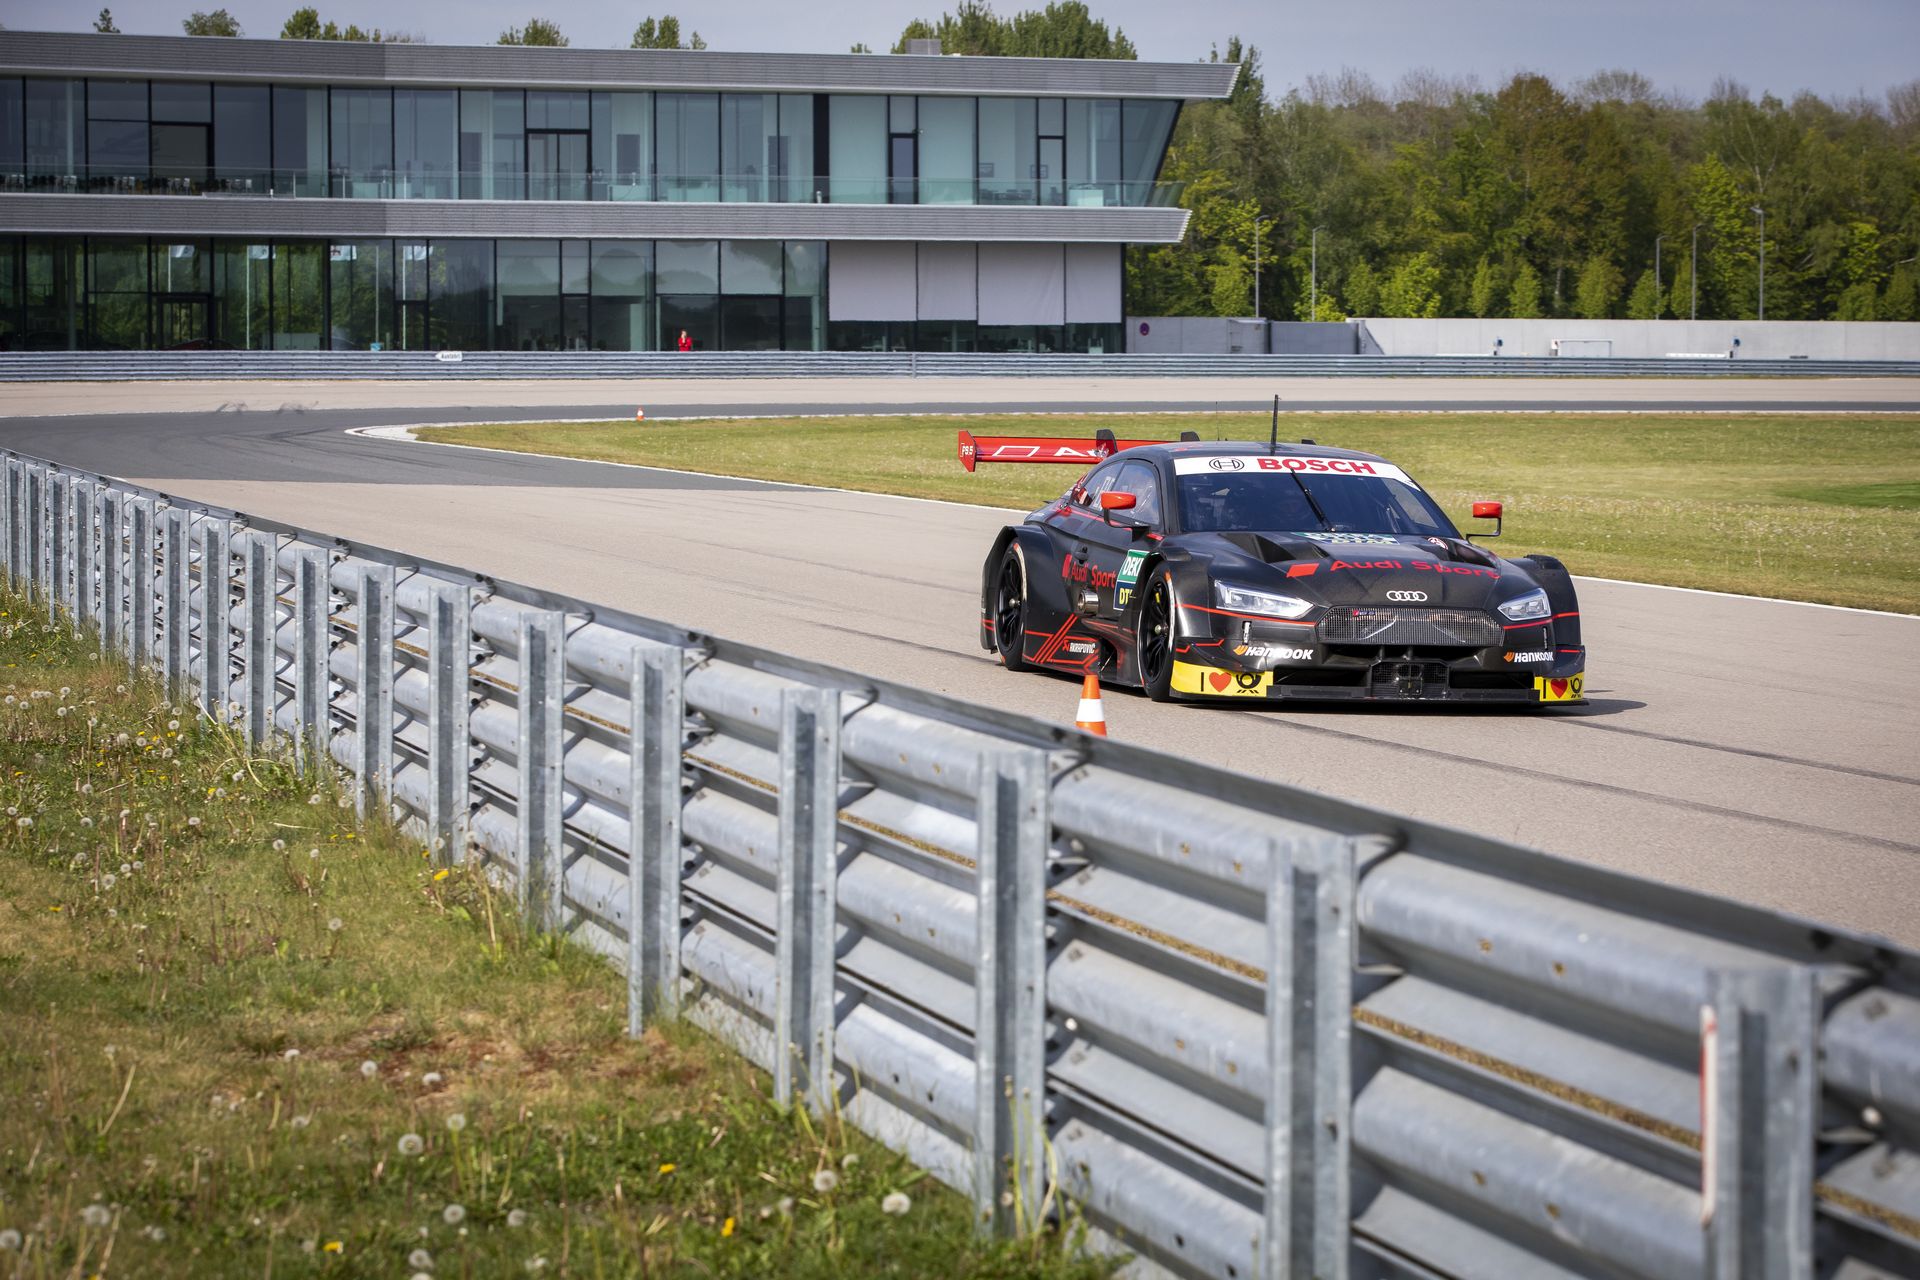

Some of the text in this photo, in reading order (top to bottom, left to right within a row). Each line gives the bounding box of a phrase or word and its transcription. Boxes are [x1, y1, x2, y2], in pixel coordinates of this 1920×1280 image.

[1257, 458, 1377, 475] BOSCH
[1071, 560, 1117, 591] Audi Sport
[1330, 560, 1500, 579] Audi Sport
[1118, 587, 1136, 605] DT
